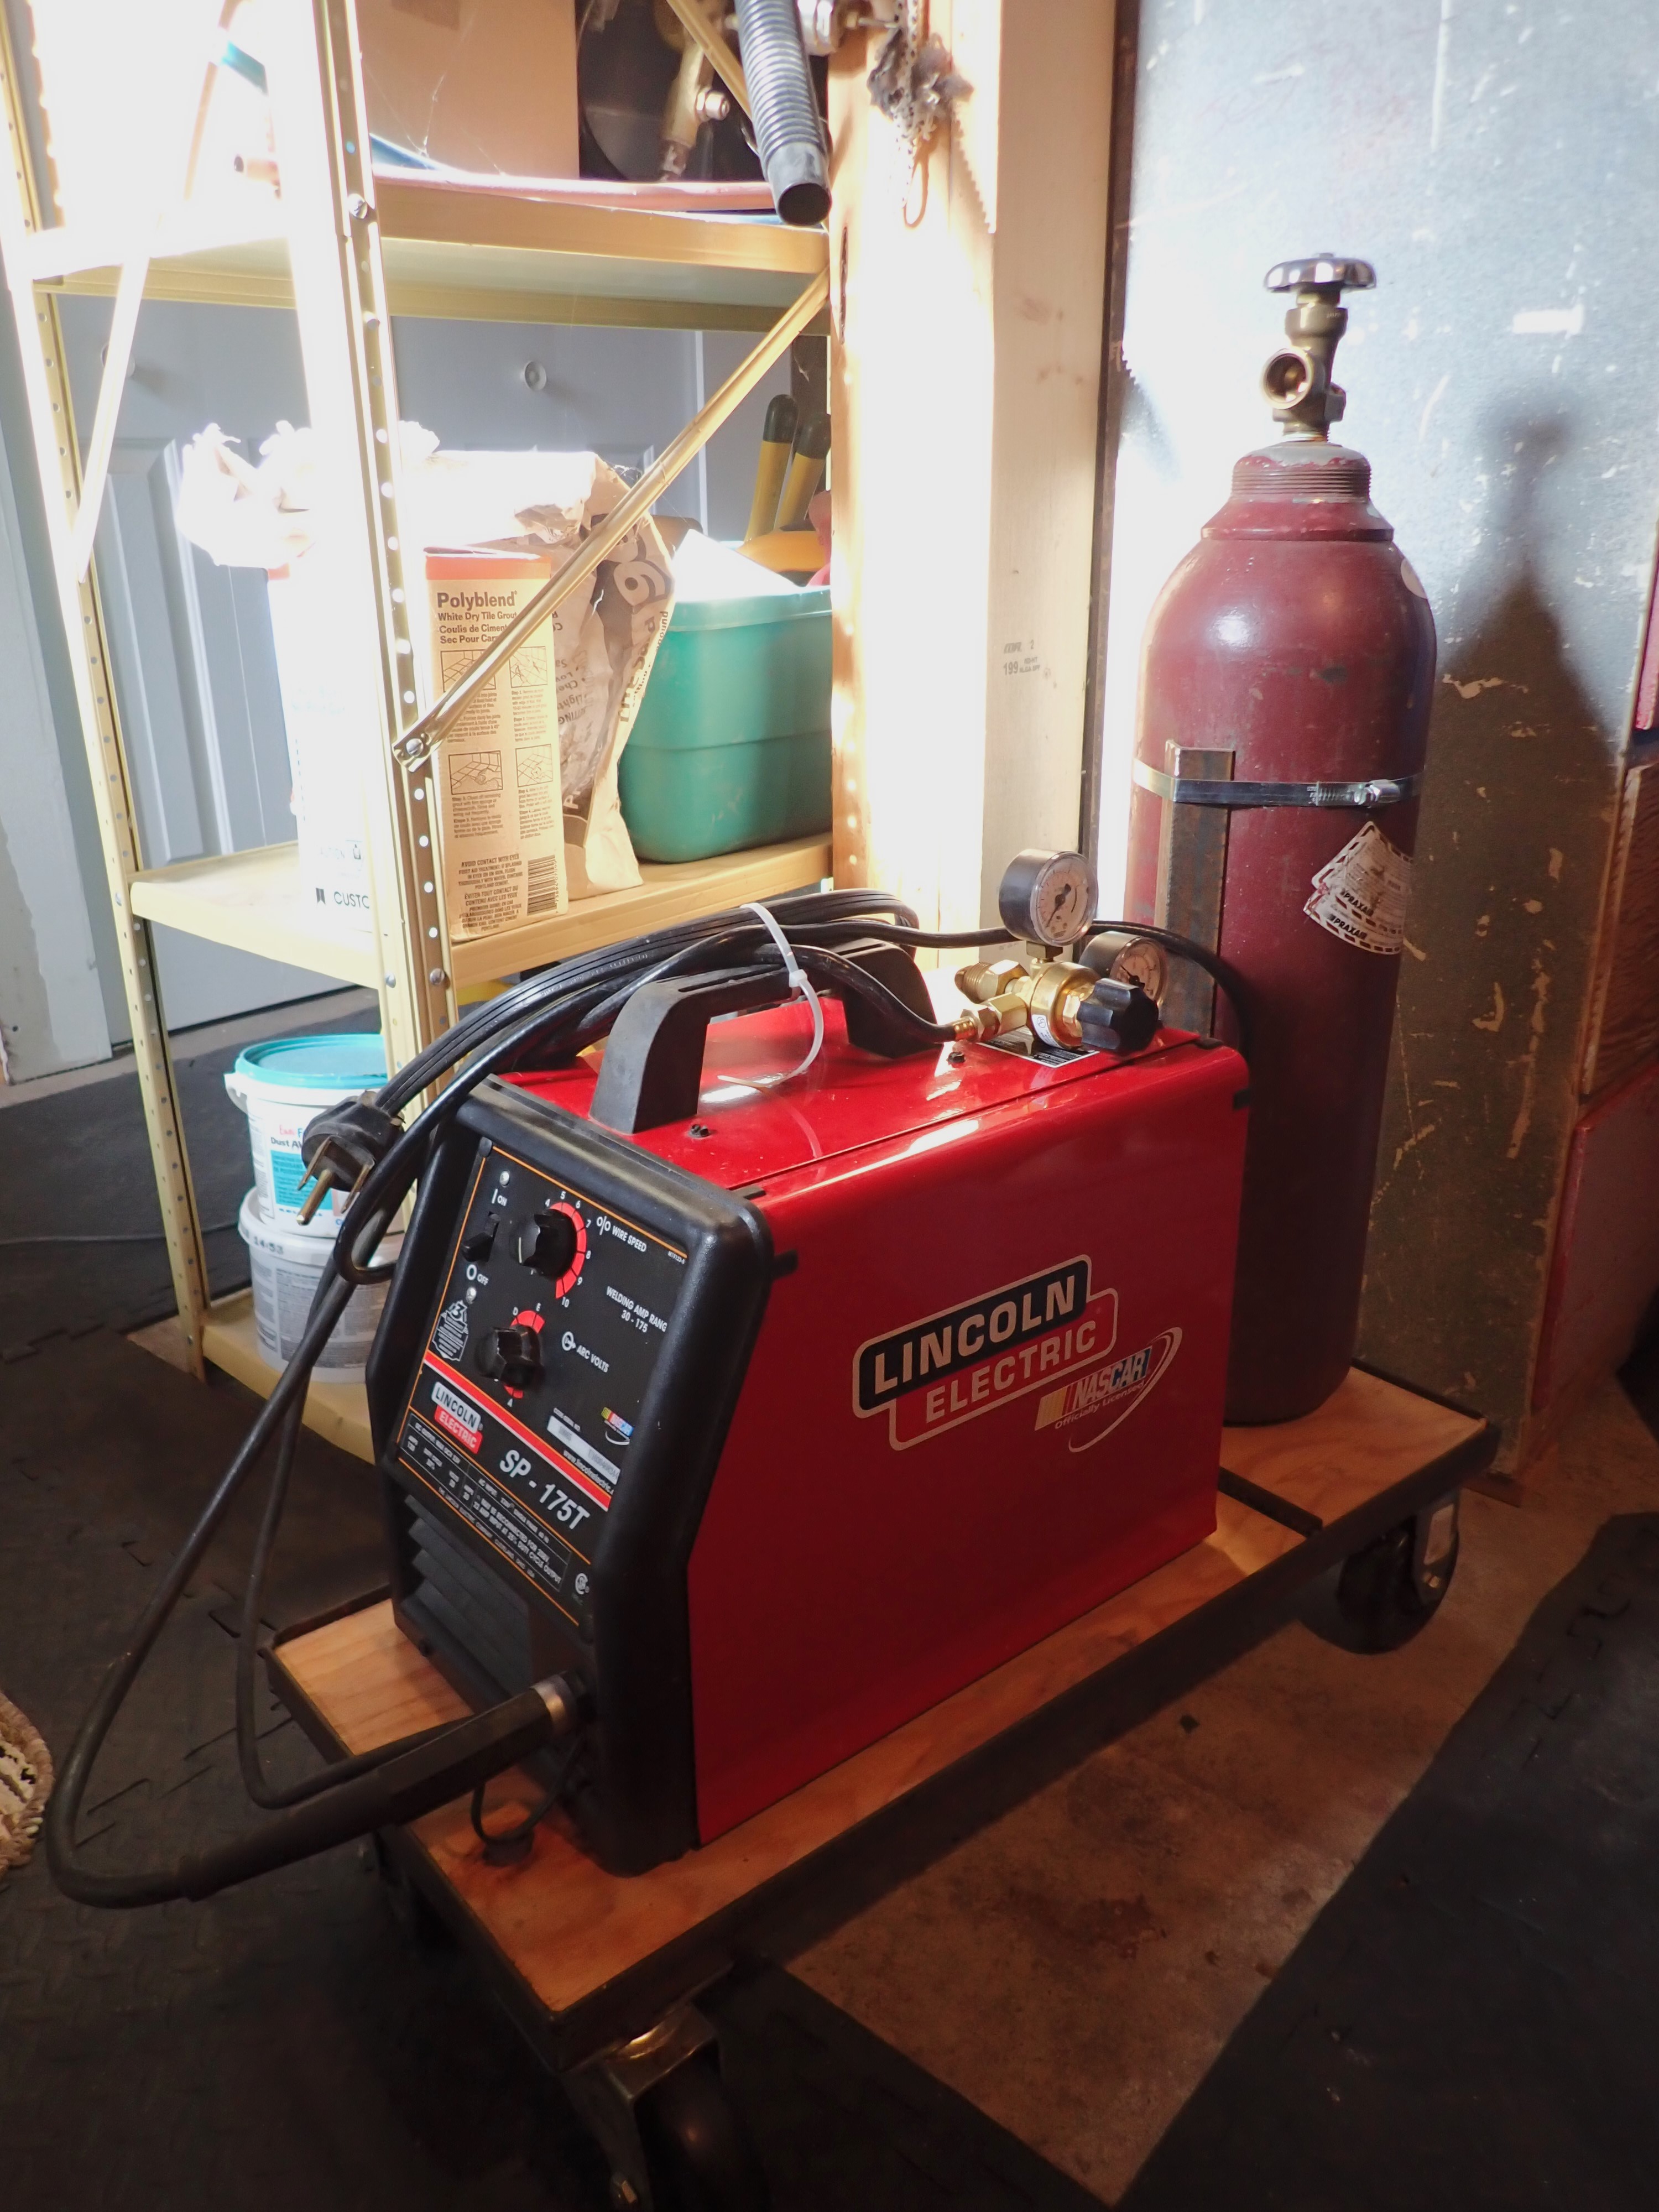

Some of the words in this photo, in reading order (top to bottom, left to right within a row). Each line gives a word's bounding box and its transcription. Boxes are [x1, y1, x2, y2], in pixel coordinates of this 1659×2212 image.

[437, 591, 515, 611] Polyblend
[438, 612, 463, 620] White
[465, 612, 479, 622] Dry
[440, 635, 457, 644] Sec
[477, 857, 497, 865] CONTACT
[271, 1137, 289, 1146] Dust
[561, 1191, 566, 1199] 5
[497, 1196, 508, 1207] ON
[545, 1199, 551, 1207] 4
[576, 1200, 581, 1209] 6
[611, 1225, 627, 1241] WIRE
[627, 1235, 647, 1253] SPEED
[586, 1250, 591, 1259] 8
[477, 1274, 488, 1285] OFF
[577, 1277, 583, 1285] 9
[536, 1302, 541, 1312] E
[561, 1296, 570, 1308] 10
[606, 1286, 634, 1311] WELDING
[633, 1303, 649, 1320] AMP
[513, 1307, 519, 1316] D
[621, 1309, 630, 1322] 30
[635, 1318, 648, 1333] 175
[874, 1274, 1075, 1395] LINCOLN
[576, 1344, 590, 1360] ARC
[589, 1353, 609, 1373] VOLTS
[925, 1320, 1097, 1423] ELECTRIC
[1072, 1351, 1147, 1411] NASCAR
[436, 1387, 476, 1428] LINCOLN
[507, 1399, 513, 1407] A
[1055, 1402, 1100, 1430] Officially
[1102, 1380, 1145, 1406] Licensed
[440, 1410, 476, 1449] ELECTRIC
[499, 1449, 530, 1479] SP
[540, 1484, 590, 1530] 175T
